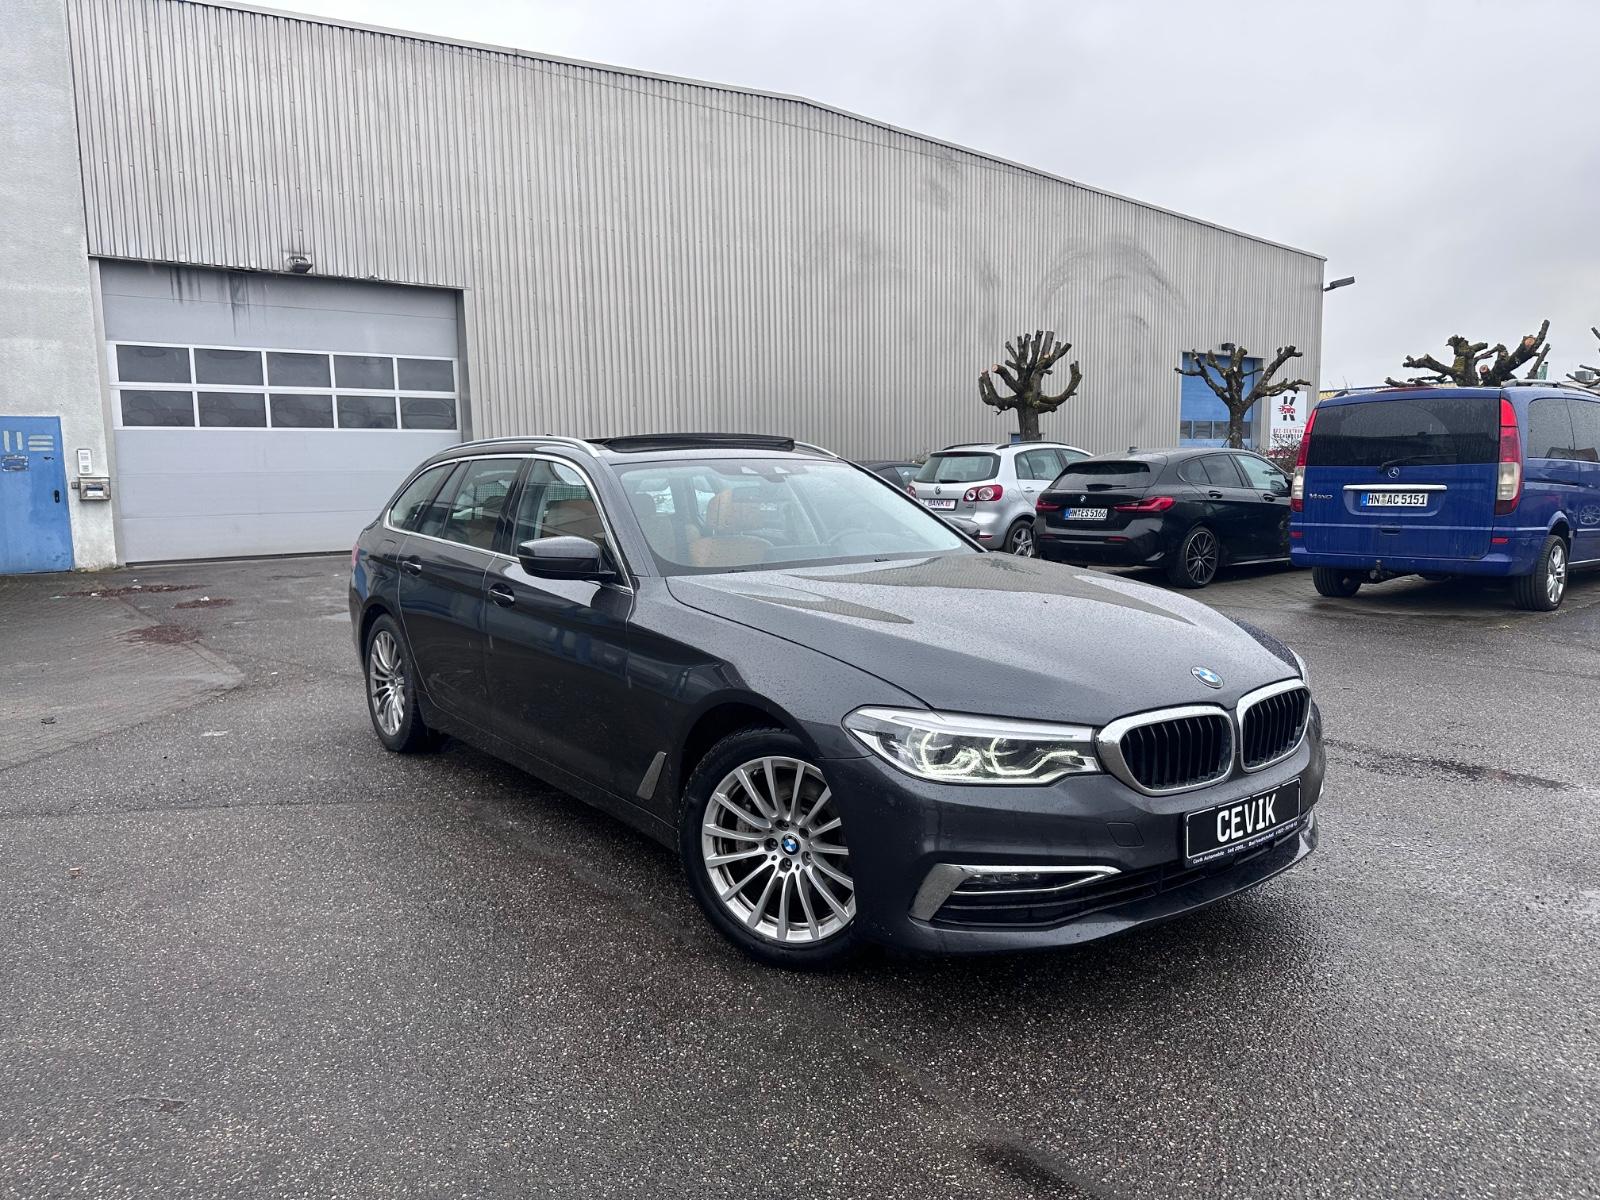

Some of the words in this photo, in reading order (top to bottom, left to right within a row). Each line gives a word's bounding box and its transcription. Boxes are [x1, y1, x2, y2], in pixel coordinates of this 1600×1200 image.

[1367, 494, 1380, 505] HN
[1386, 494, 1400, 505] AC
[1400, 494, 1426, 505] 5151
[1216, 793, 1277, 843] CEVIK
